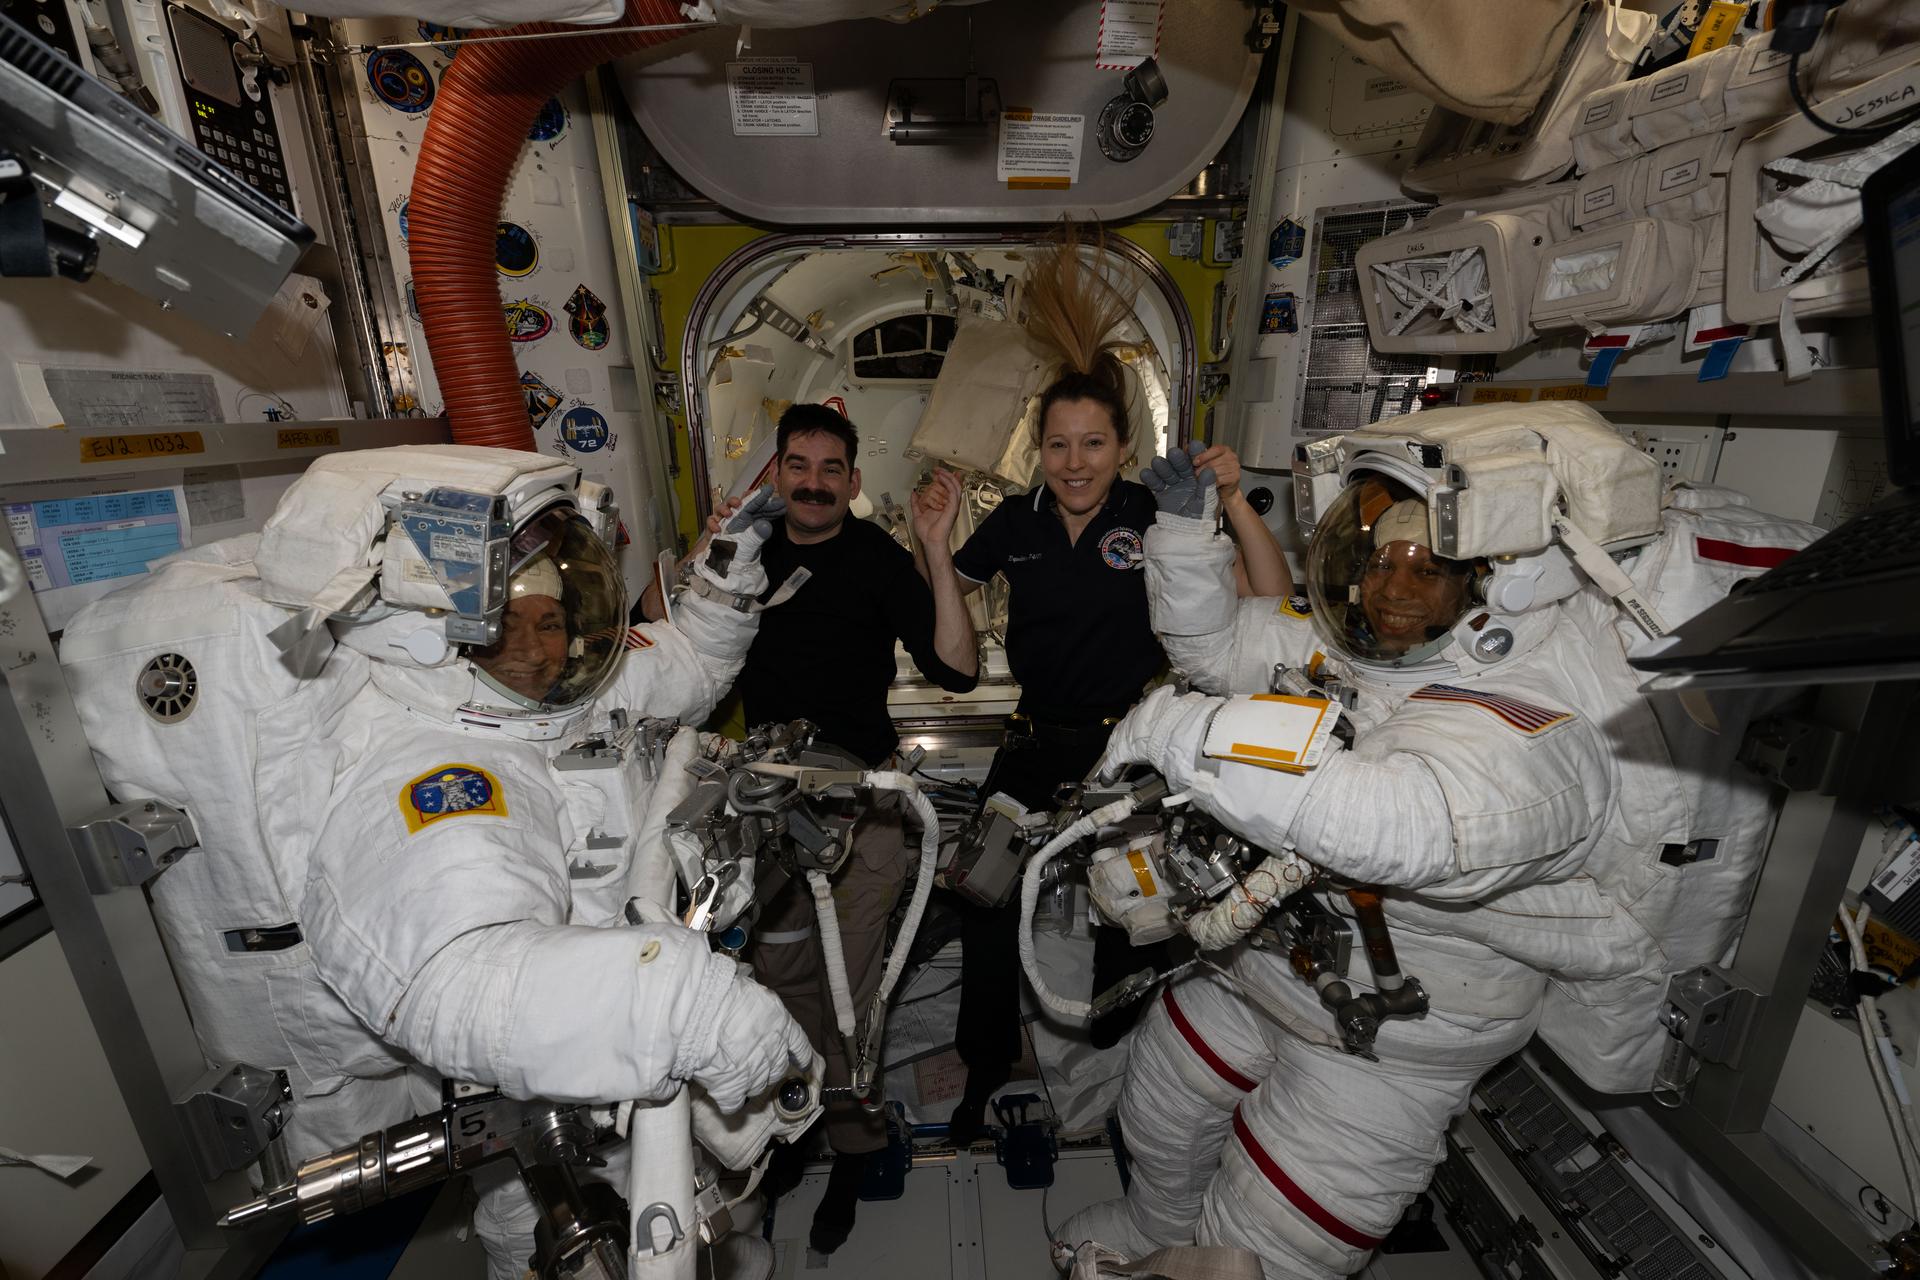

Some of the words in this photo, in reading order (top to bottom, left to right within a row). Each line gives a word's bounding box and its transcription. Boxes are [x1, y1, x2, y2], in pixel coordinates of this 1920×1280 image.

[742, 66, 774, 74] CLOSING
[775, 66, 801, 74] HATCH
[1836, 86, 1916, 124] JESSICA
[149, 433, 190, 452] 1032
[578, 439, 598, 449] 72
[460, 1109, 486, 1137] 5
